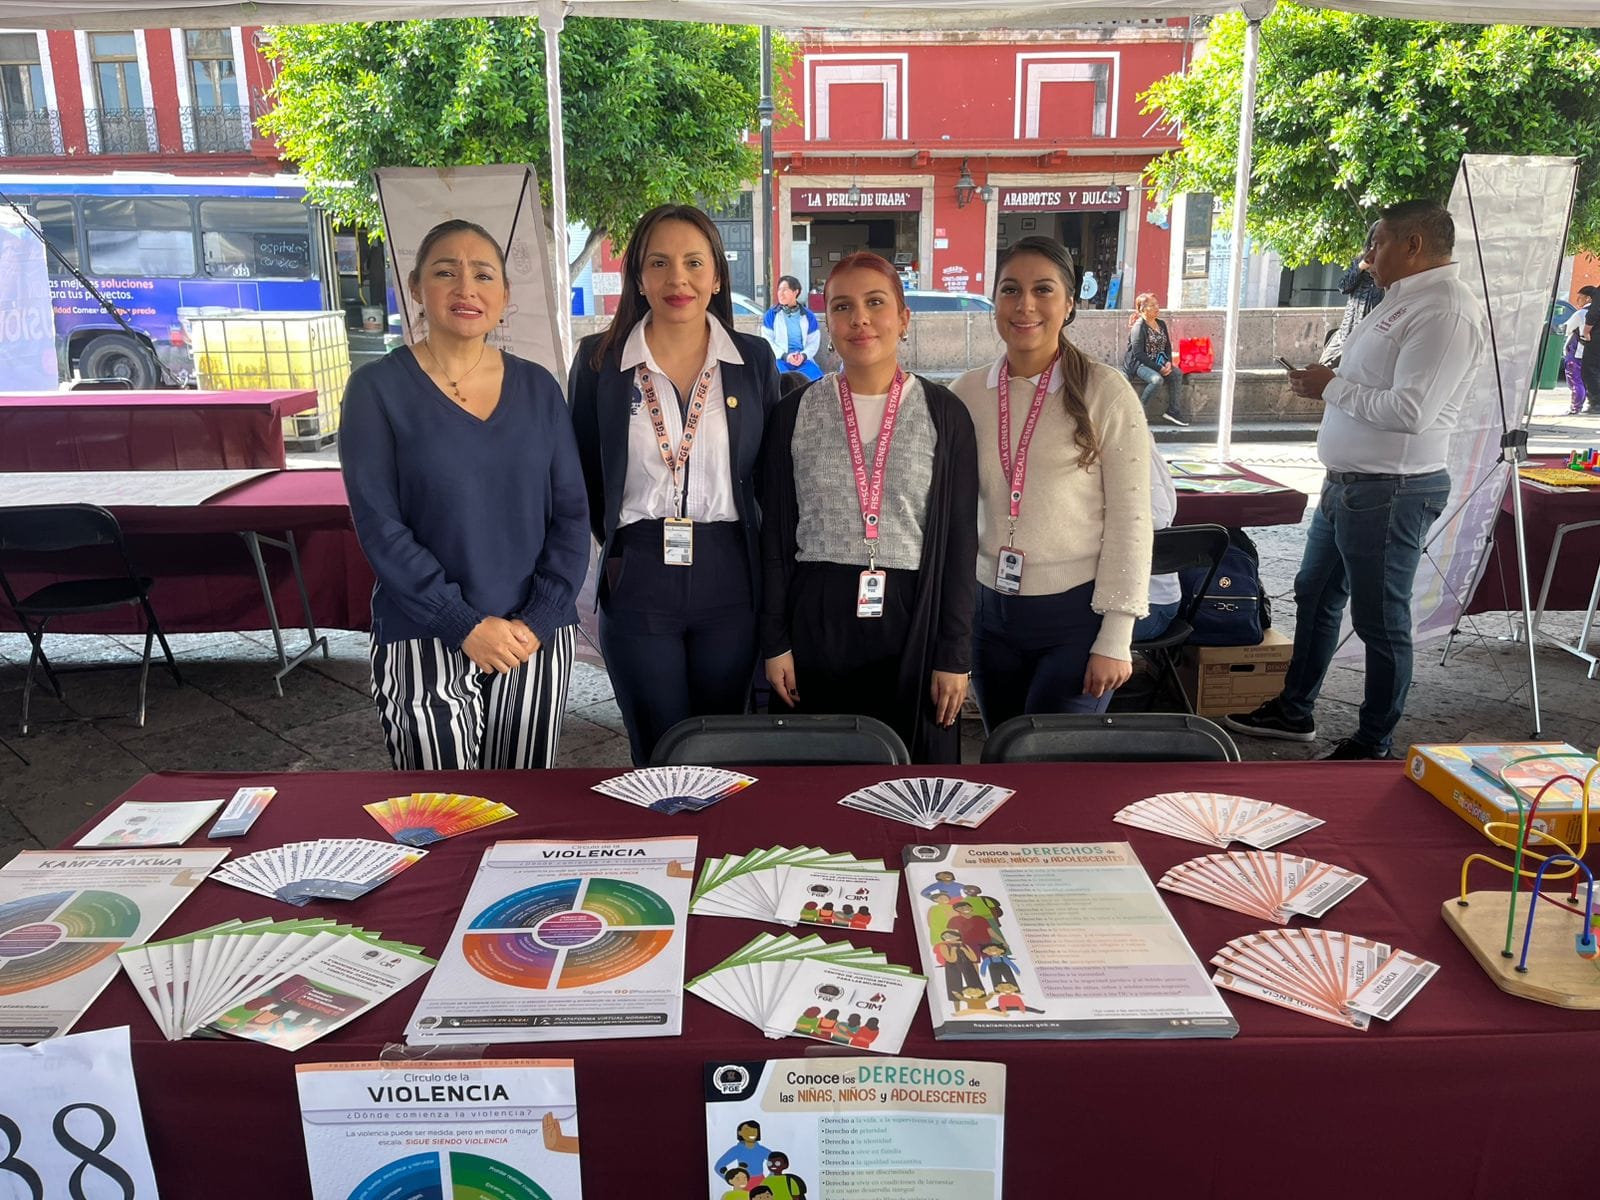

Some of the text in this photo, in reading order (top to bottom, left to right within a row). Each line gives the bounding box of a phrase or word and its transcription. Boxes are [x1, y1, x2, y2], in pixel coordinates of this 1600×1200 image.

[860, 192, 874, 206] DE
[1003, 192, 1062, 206] ABARROTES
[1068, 192, 1078, 205] Y
[101, 278, 154, 289] soluciones
[68, 290, 84, 299] tus
[645, 386, 657, 404] FGE
[840, 382, 853, 412] ESTADO
[888, 385, 900, 413] ESTADO
[678, 382, 708, 462] FGE FGE FGE
[846, 412, 856, 428] DEL
[884, 414, 894, 430] DEL
[1000, 396, 1009, 450] GENERAL DEL
[1022, 407, 1039, 446] GENERAL
[1034, 391, 1044, 407] DEL
[654, 420, 666, 438] FGE
[849, 428, 863, 465] GENERAL
[876, 430, 890, 468] GENERAL
[542, 848, 647, 859] VIOLENCIA
[968, 849, 1008, 857] Conoce
[1021, 846, 1103, 856] DERECHOS
[1050, 854, 1125, 863] ADOLESCENTES
[38, 858, 182, 869] KAMPERAKWA
[1373, 972, 1400, 995] VIOLENCIA
[444, 1073, 458, 1082] de
[460, 1072, 470, 1081] la
[786, 1066, 980, 1087] Conoce los DERECHOS de
[367, 1084, 510, 1103] VIOLENCIA
[780, 1086, 987, 1104] las NIÑAS, NIÑOS y ADOLESCENTES
[346, 1109, 532, 1120] ¿Dónde comienza la violencia?
[356, 1129, 390, 1137] violencia
[390, 1130, 413, 1139] puede
[456, 1129, 473, 1138] pero
[515, 1128, 538, 1136] mayor
[405, 1138, 430, 1146] SIGUE
[464, 1137, 509, 1145] VIOLENCIA
